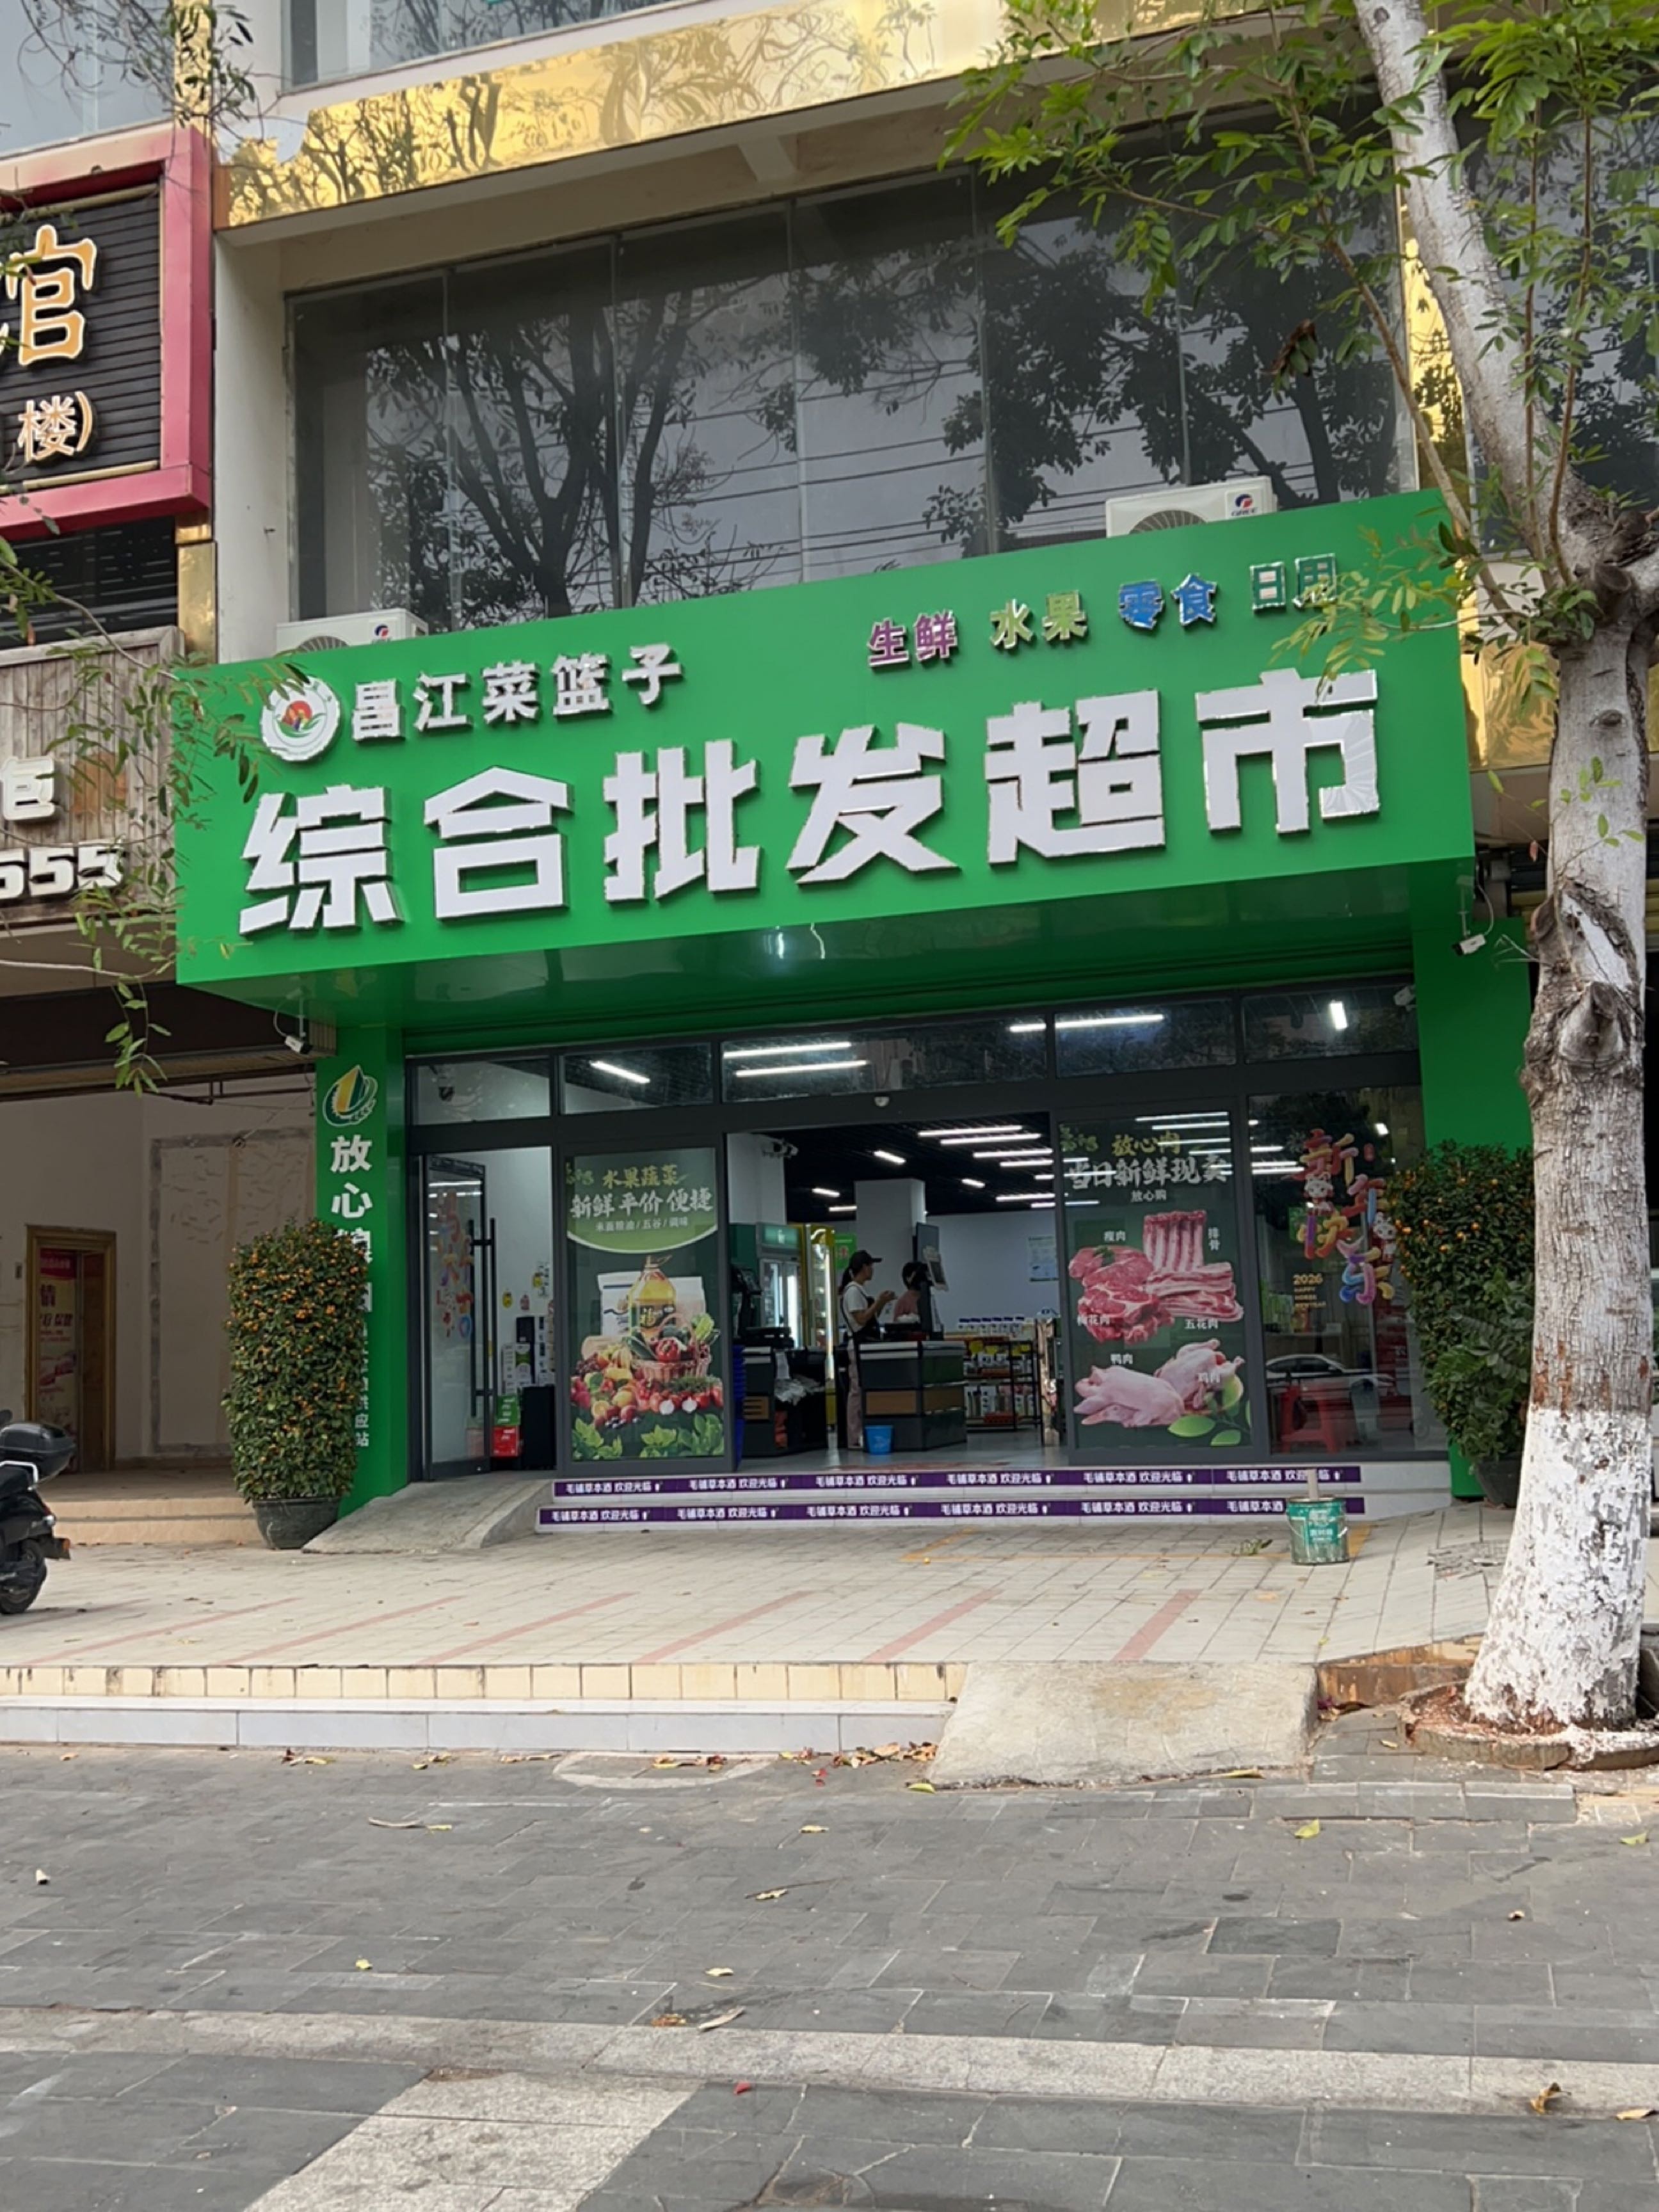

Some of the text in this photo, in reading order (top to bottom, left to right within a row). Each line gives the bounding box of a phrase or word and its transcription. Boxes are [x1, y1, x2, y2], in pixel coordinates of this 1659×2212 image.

[0, 224, 97, 367] 官
[868, 553, 1338, 669] 生鲜 水果 零食 日用
[351, 643, 684, 742] 昌江菜篮子
[239, 667, 1381, 937] 综合批发超市
[1112, 1131, 1182, 1157] 放心肉
[1070, 1154, 1228, 1189] 当日新鲜现卖
[1293, 1273, 1324, 1285] 2026
[1185, 1318, 1219, 1330] 五花肉
[1285, 1470, 1329, 1480] 欢迎临
